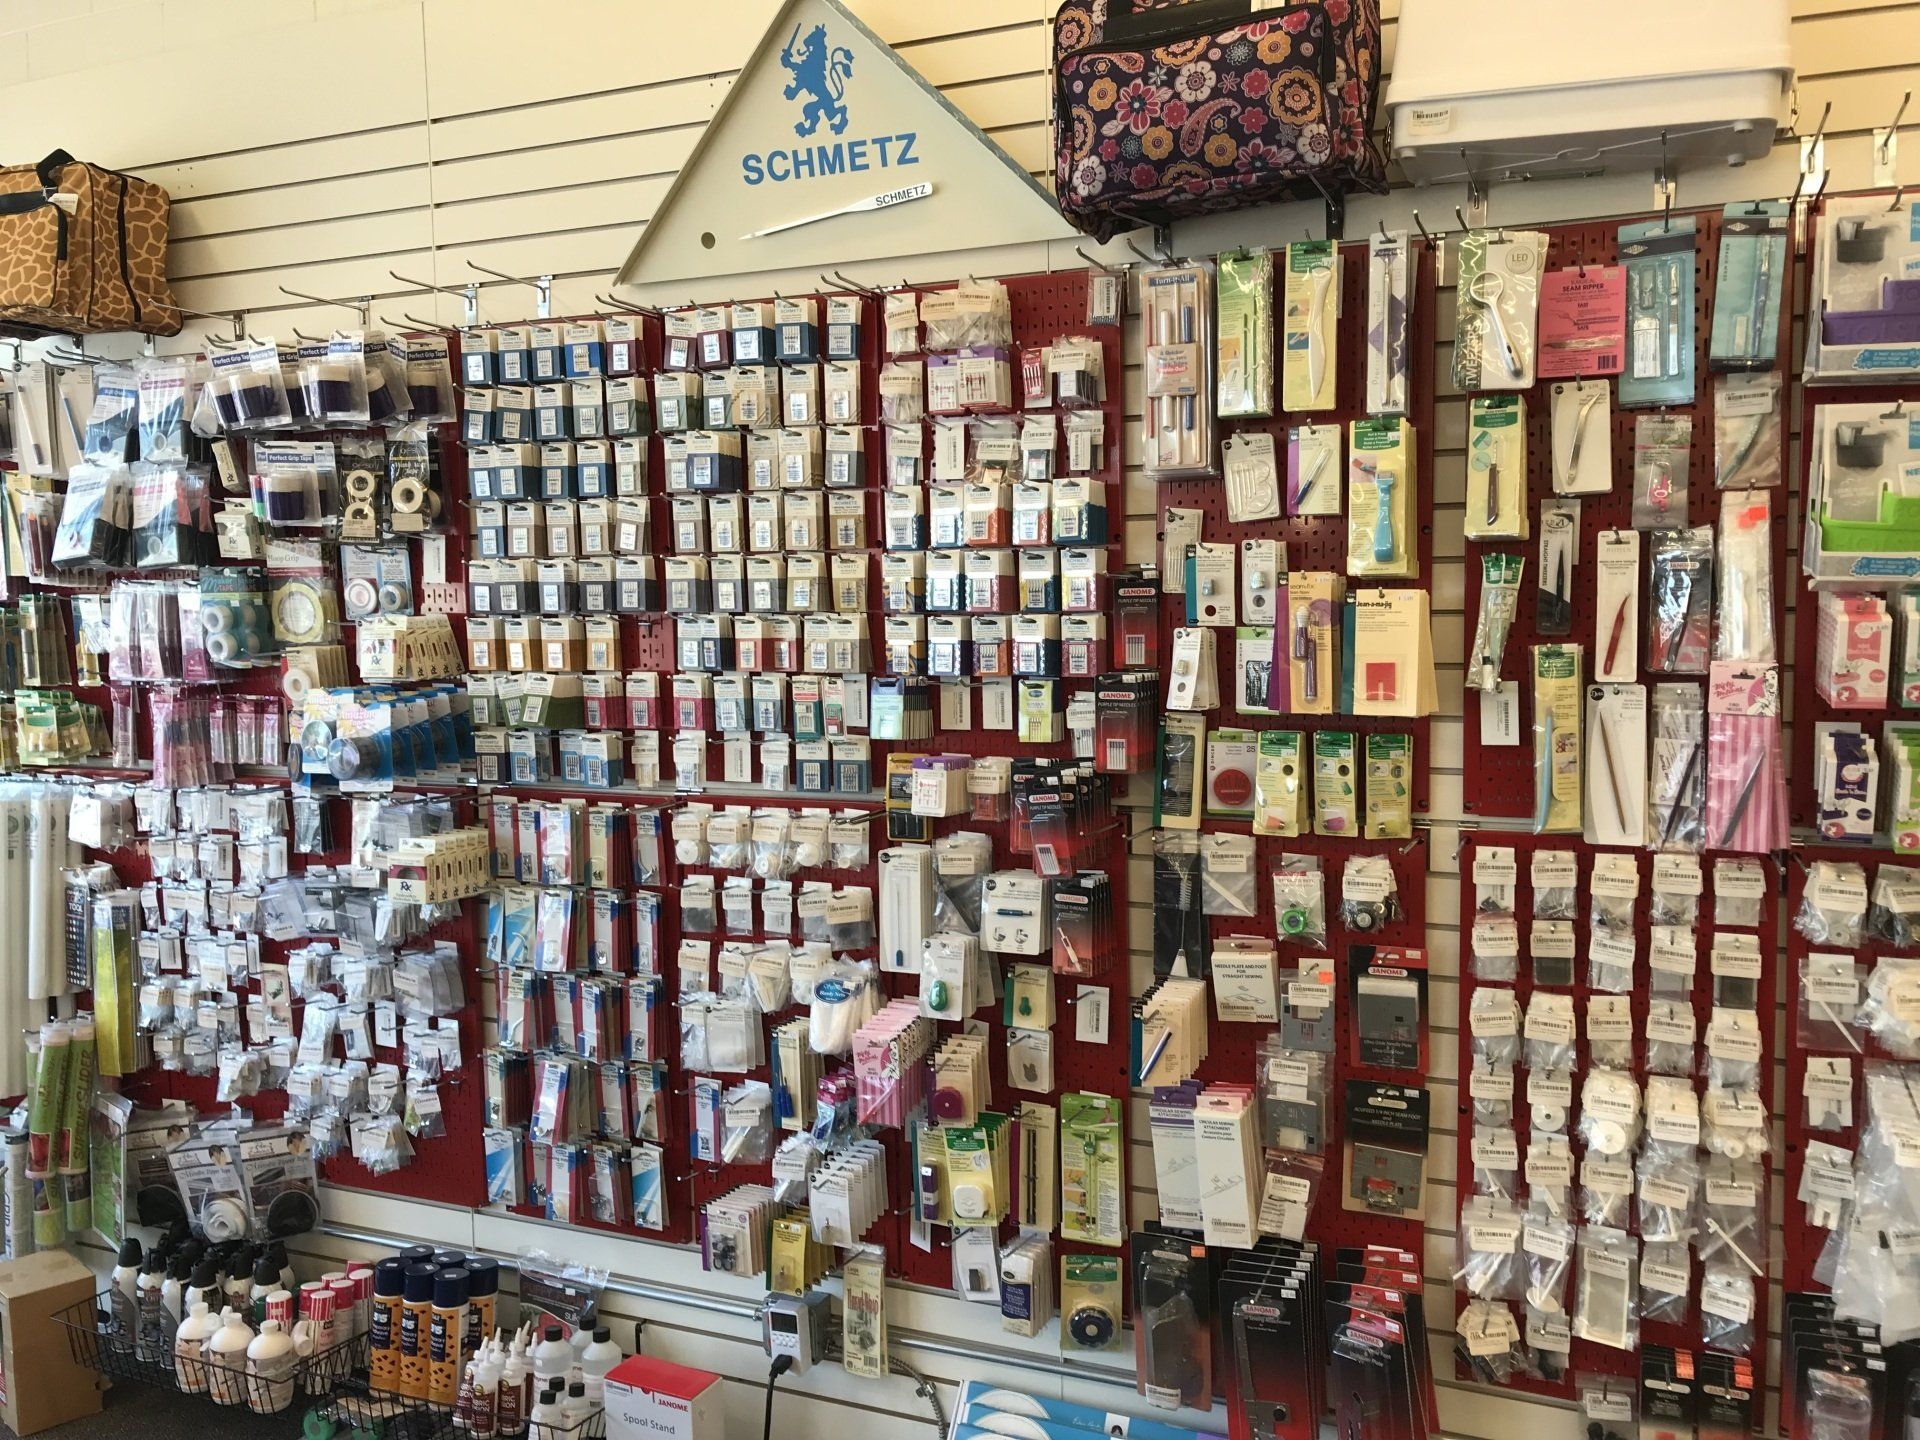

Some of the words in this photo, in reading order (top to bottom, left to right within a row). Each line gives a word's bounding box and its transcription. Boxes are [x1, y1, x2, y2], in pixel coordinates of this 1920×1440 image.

[742, 132, 919, 186] SCHMETZ
[875, 184, 927, 207] SCHMETZ
[1511, 254, 1528, 262] LED
[300, 347, 318, 357] Perfect
[318, 347, 329, 356] Gr
[330, 344, 344, 352] Perfect
[1466, 318, 1481, 386] TWEEZERS
[213, 356, 229, 366] Perfect
[230, 355, 240, 364] Grip
[408, 352, 427, 360] Perfect
[427, 353, 436, 361] Grip
[436, 350, 447, 360] Tape
[268, 454, 287, 462] Perfect
[288, 454, 299, 464] Grip
[299, 454, 312, 464] Tape
[284, 554, 300, 564] Grip
[1356, 600, 1392, 609] Jean-a-ma-jig
[1032, 794, 1056, 802] JANOME
[1370, 968, 1404, 976] JANOME
[76, 1050, 94, 1105] SLIDER
[1246, 1306, 1277, 1314] JANOME
[1350, 1330, 1380, 1346] JANOME
[658, 1398, 689, 1413] JANOME
[623, 1412, 648, 1427] Spool
[650, 1420, 676, 1434] Stand
